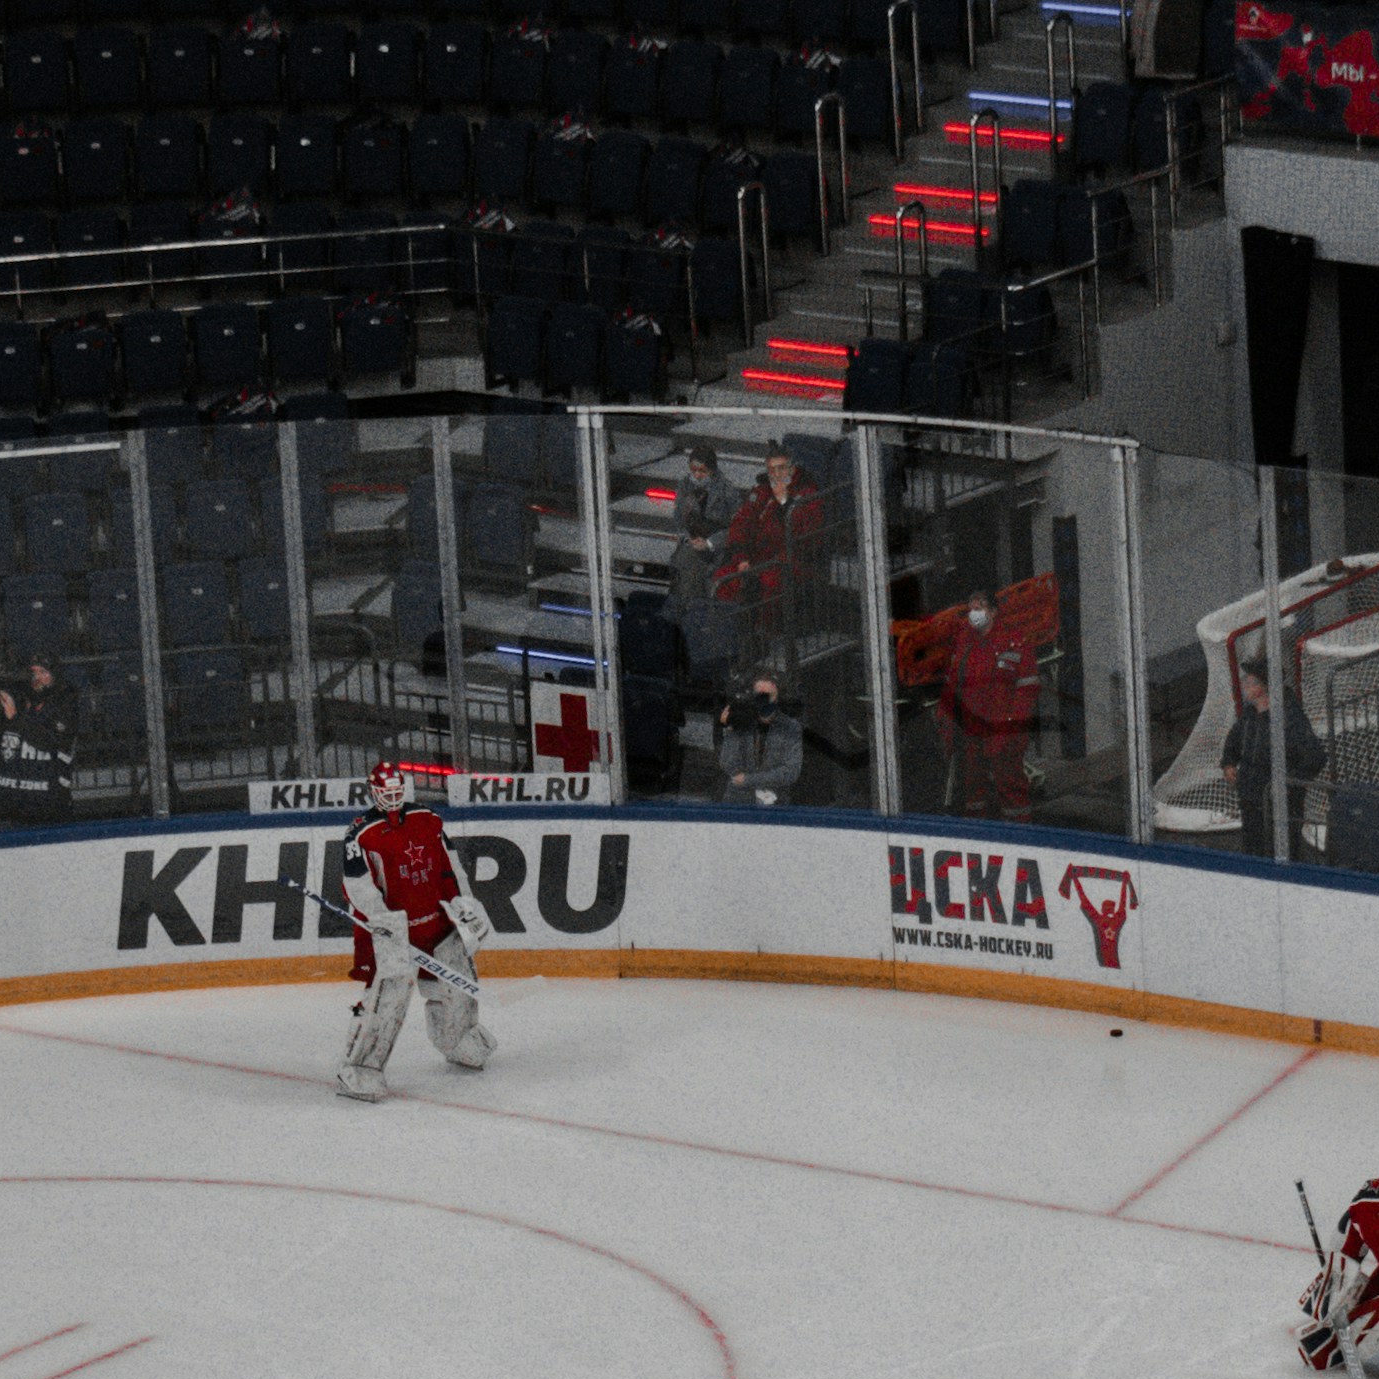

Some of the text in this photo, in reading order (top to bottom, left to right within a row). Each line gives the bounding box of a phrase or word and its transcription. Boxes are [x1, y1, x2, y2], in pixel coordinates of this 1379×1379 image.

[1331, 61, 1364, 82] МЫ
[270, 783, 370, 810] KHL.R
[469, 777, 590, 802] KHL.RU
[888, 845, 1050, 929] ЦСКА
[893, 926, 1054, 961] WWW.CSKA-HOCKEY.RU
